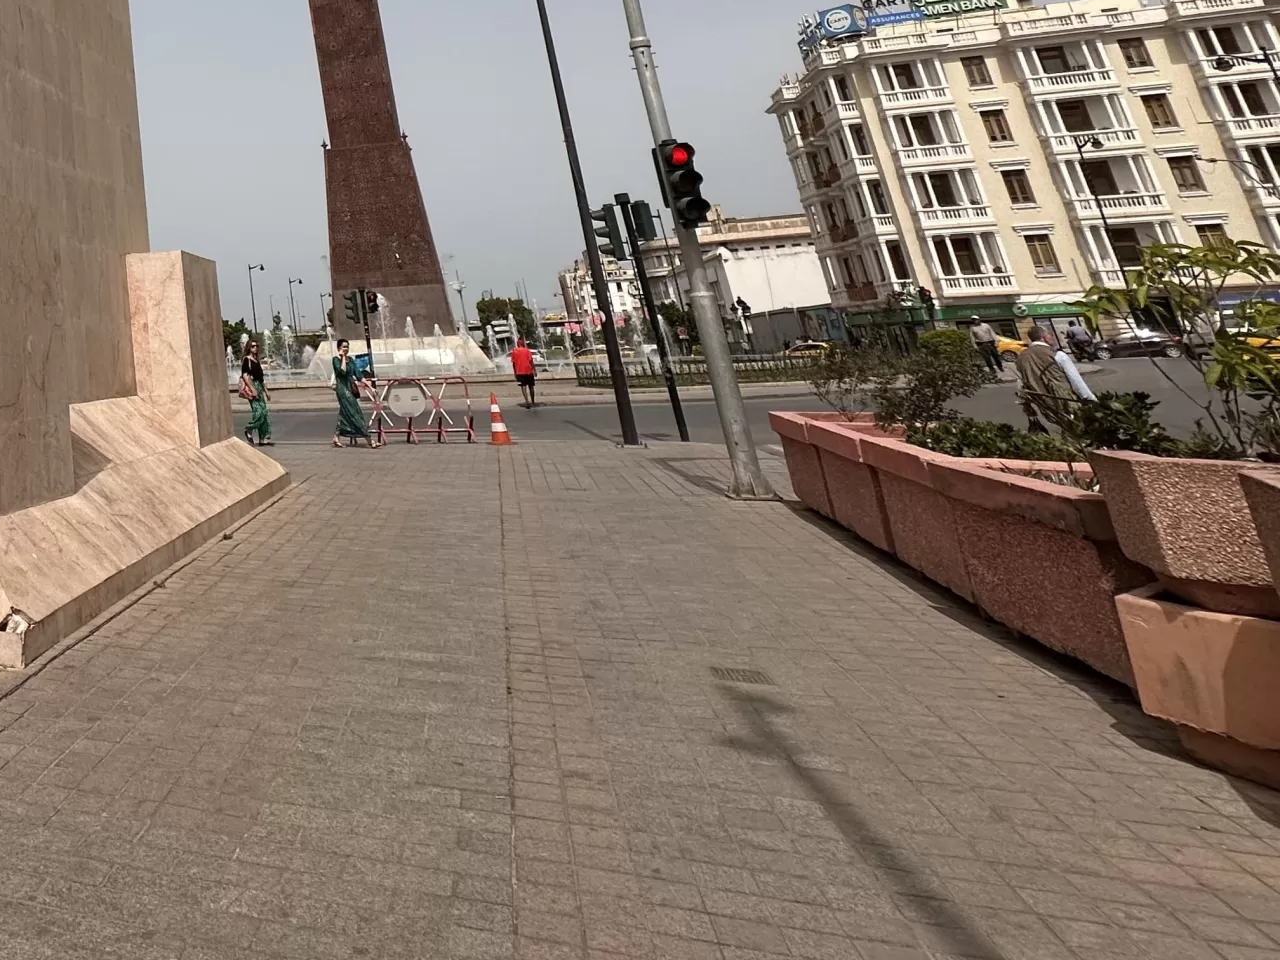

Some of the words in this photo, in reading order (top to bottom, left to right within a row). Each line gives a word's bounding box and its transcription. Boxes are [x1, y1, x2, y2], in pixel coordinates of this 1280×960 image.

[919, 3, 960, 17] AMEN
[829, 16, 849, 25] CARTE
[871, 12, 921, 24] ASSURANCES
